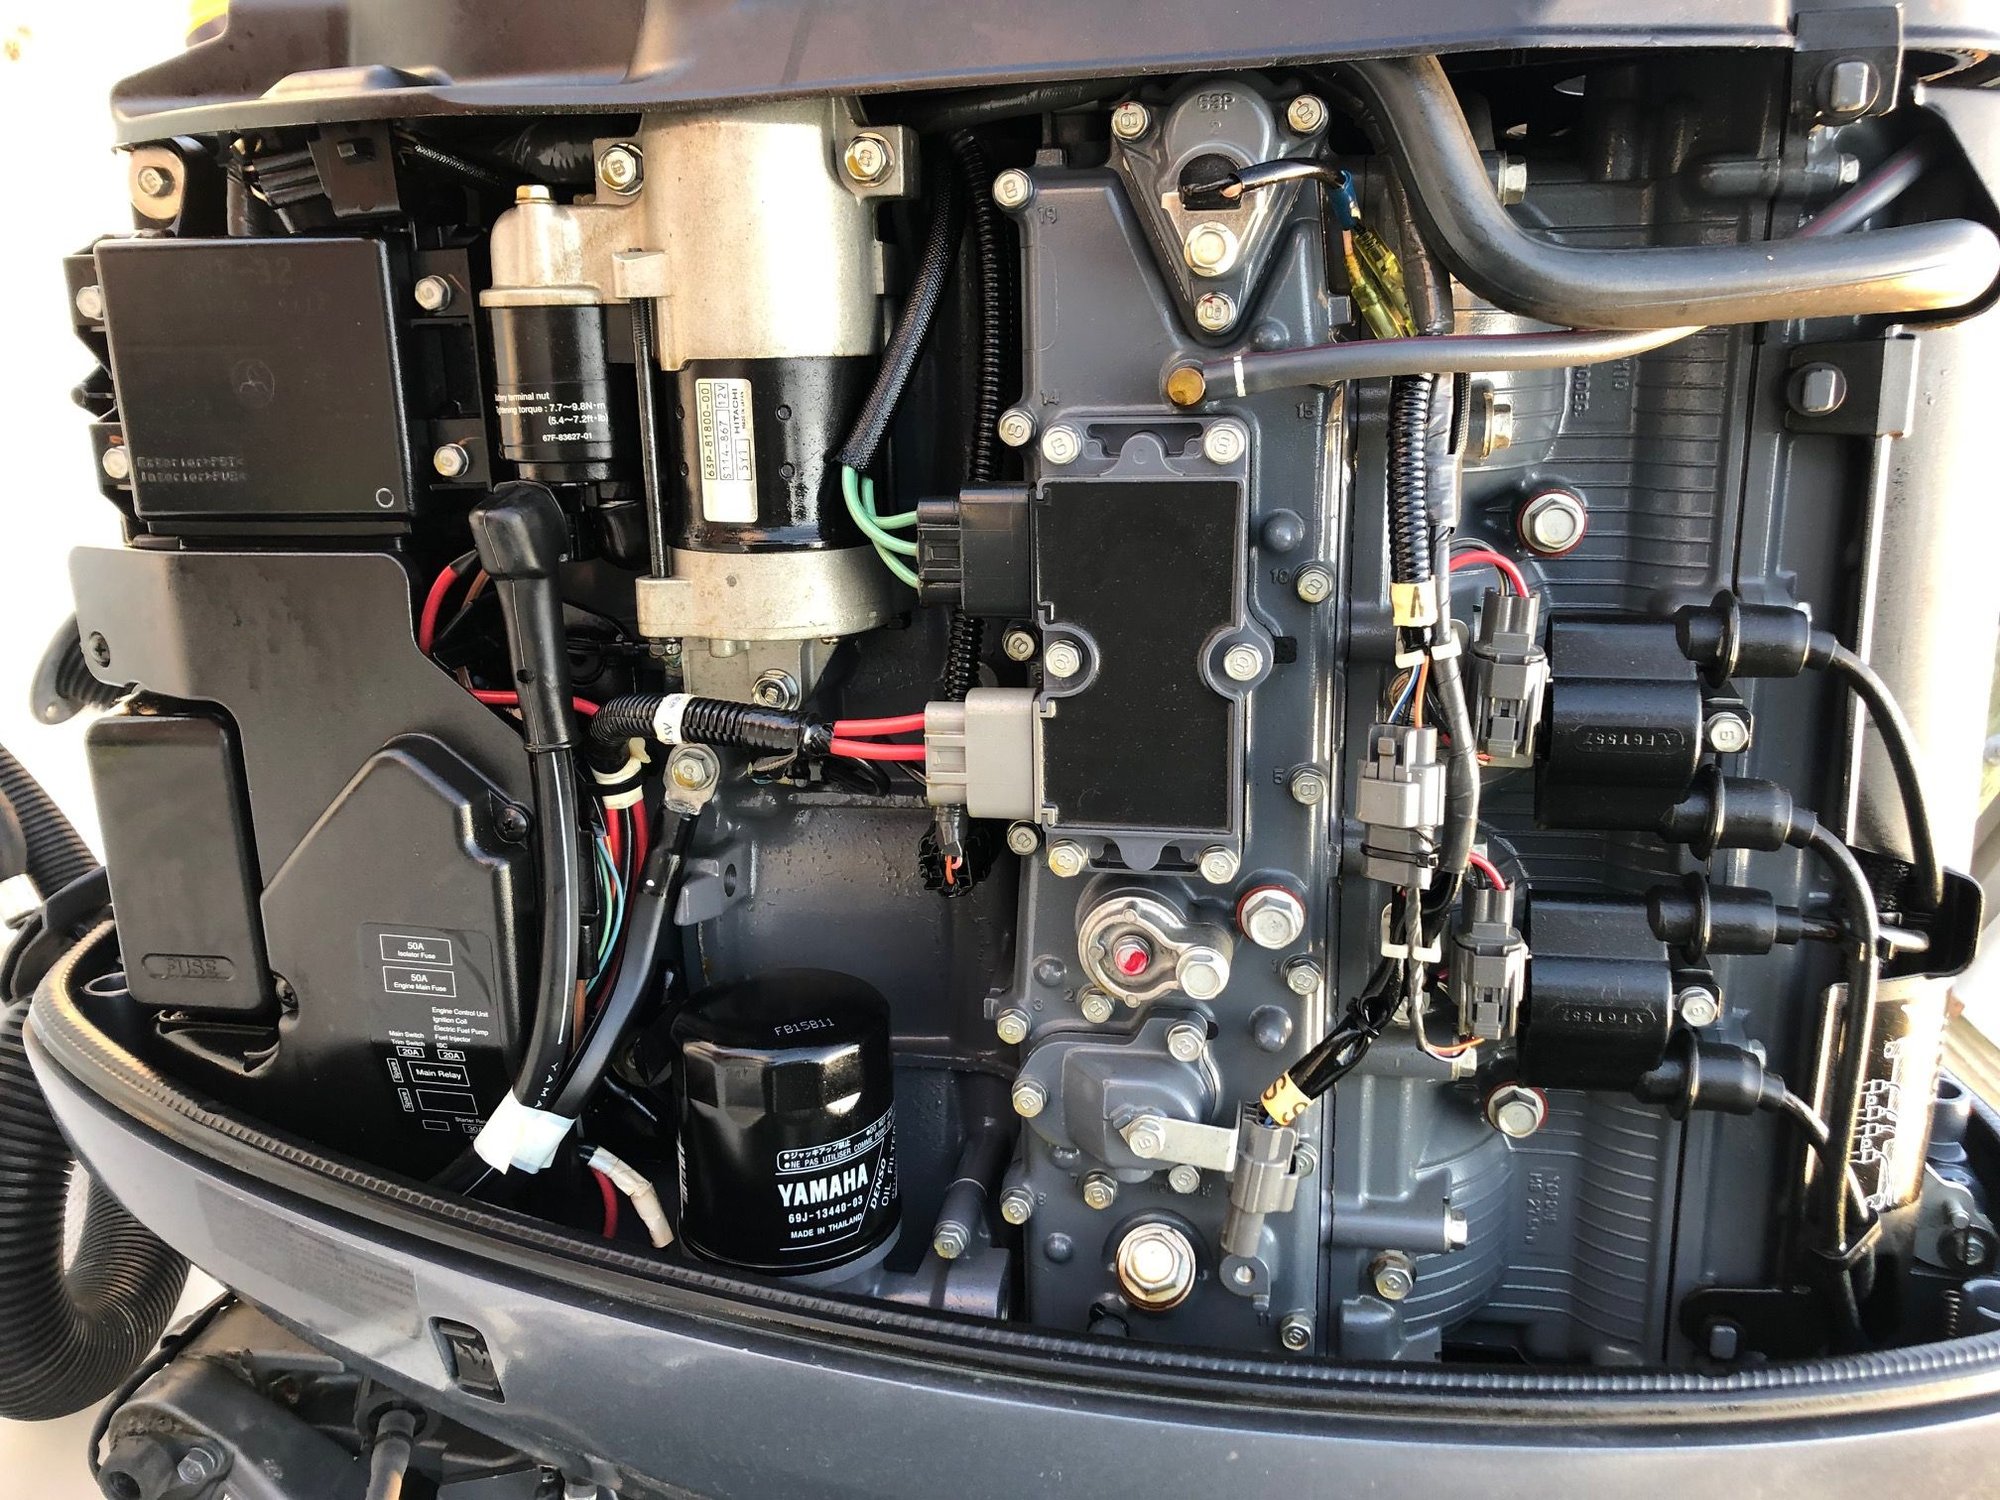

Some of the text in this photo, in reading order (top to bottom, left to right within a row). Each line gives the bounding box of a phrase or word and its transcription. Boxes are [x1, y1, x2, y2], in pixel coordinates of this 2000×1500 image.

[536, 391, 550, 400] nut
[716, 383, 728, 406] 12V
[518, 405, 543, 415] torque
[731, 388, 741, 434] HITACHI
[542, 432, 593, 442] 67F-83627-01
[701, 387, 715, 477] 63P-81800-00
[718, 420, 732, 479] S114-867
[1272, 768, 1284, 785] 5
[407, 941, 424, 951] 50A
[397, 950, 436, 960] Isolator Fuse
[163, 956, 219, 979] FUSE
[410, 973, 428, 983] 50A
[393, 981, 447, 992] Engine Main Fuse
[1064, 988, 1075, 1003] 2
[431, 1006, 489, 1018] Engine Control Unit
[455, 1017, 468, 1025] Coil
[773, 1017, 835, 1037] FB15B11
[404, 1031, 425, 1039] Switch
[433, 1024, 456, 1033] Electric
[471, 1028, 489, 1037] Pump
[402, 1048, 420, 1056] 20A
[442, 1051, 460, 1059] 20A
[416, 1068, 462, 1081] Main Relay
[790, 1160, 801, 1169] NE
[804, 1158, 819, 1167] PAS
[822, 1148, 852, 1163] UTILISER
[853, 1136, 873, 1152] COMME
[777, 1163, 869, 1207] YAMAHA
[869, 1158, 887, 1210] DENSO
[881, 1182, 892, 1206] OIL
[788, 1194, 863, 1224] 69J-13440-03
[790, 1212, 863, 1239] MADE IN THAILAND
